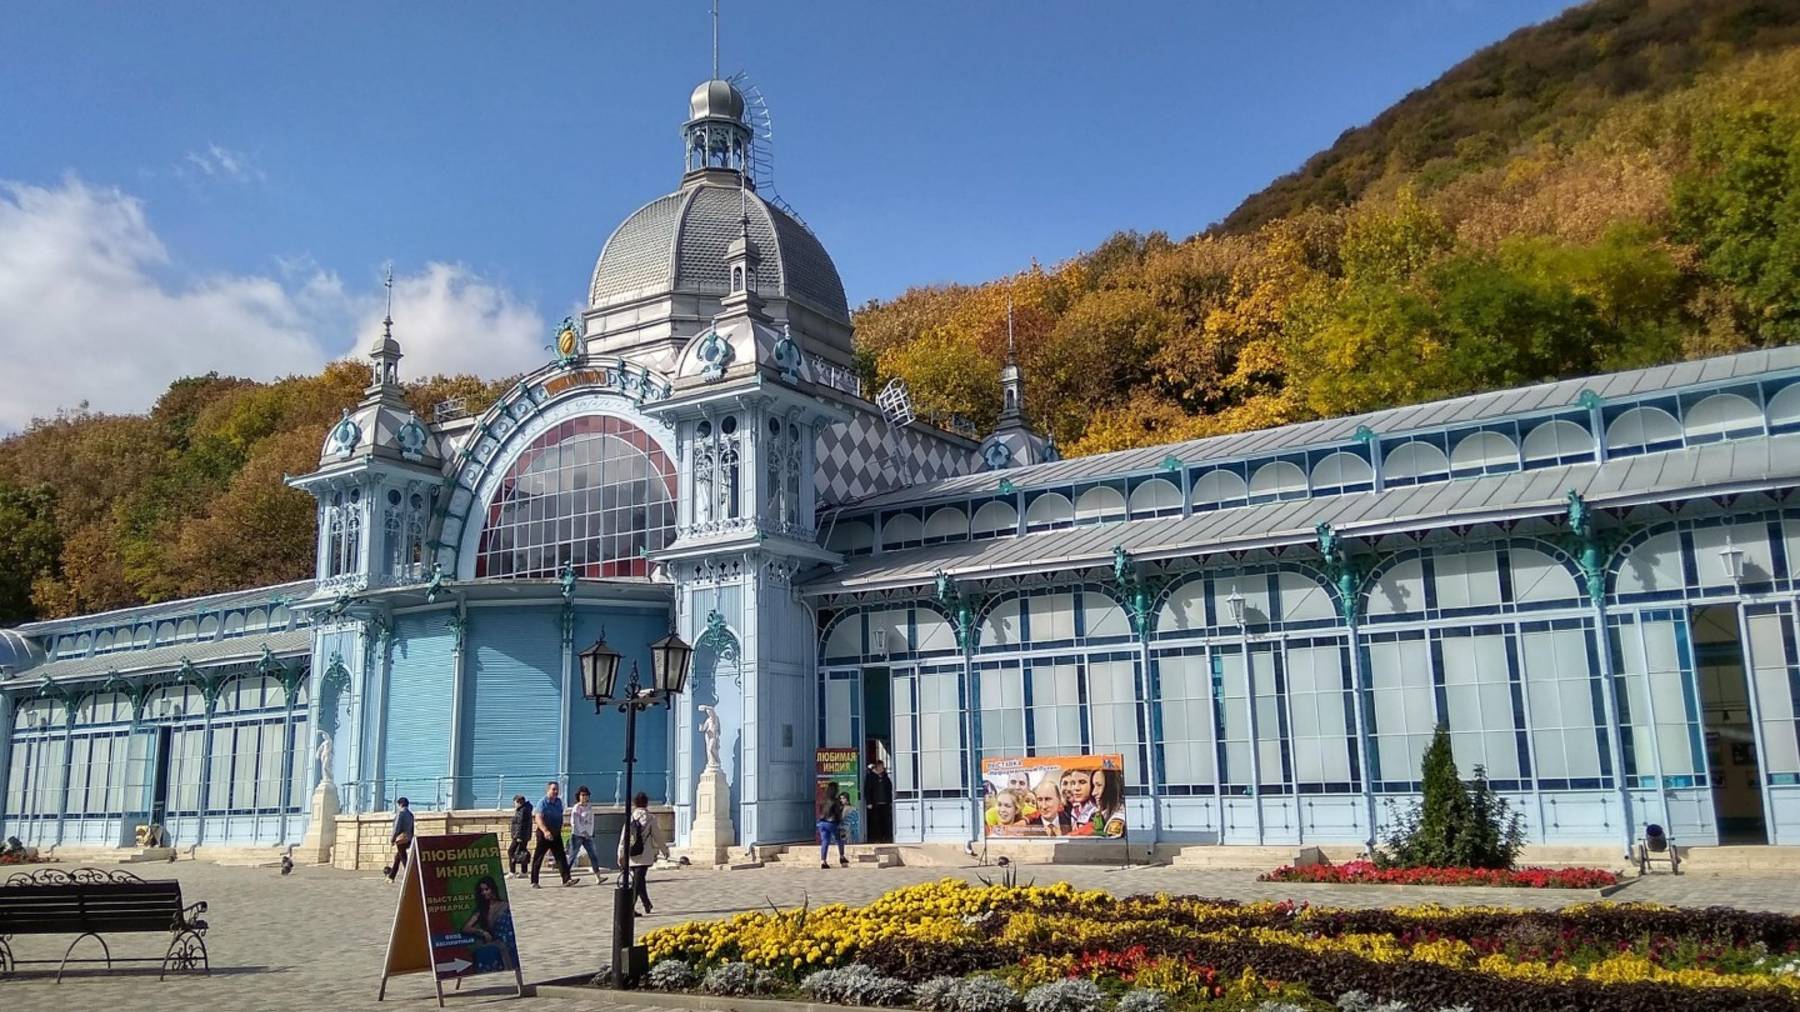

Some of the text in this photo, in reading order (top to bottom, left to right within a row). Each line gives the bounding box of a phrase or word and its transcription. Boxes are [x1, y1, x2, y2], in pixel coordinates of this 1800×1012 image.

[817, 752, 857, 762] ЛЮБИМАЯ
[823, 763, 850, 772] ИНДИЯ
[421, 847, 500, 862] ЛЮБИМАЯ
[436, 863, 489, 878] ИНДИЯ
[428, 904, 471, 912] ЯРМАРКА
